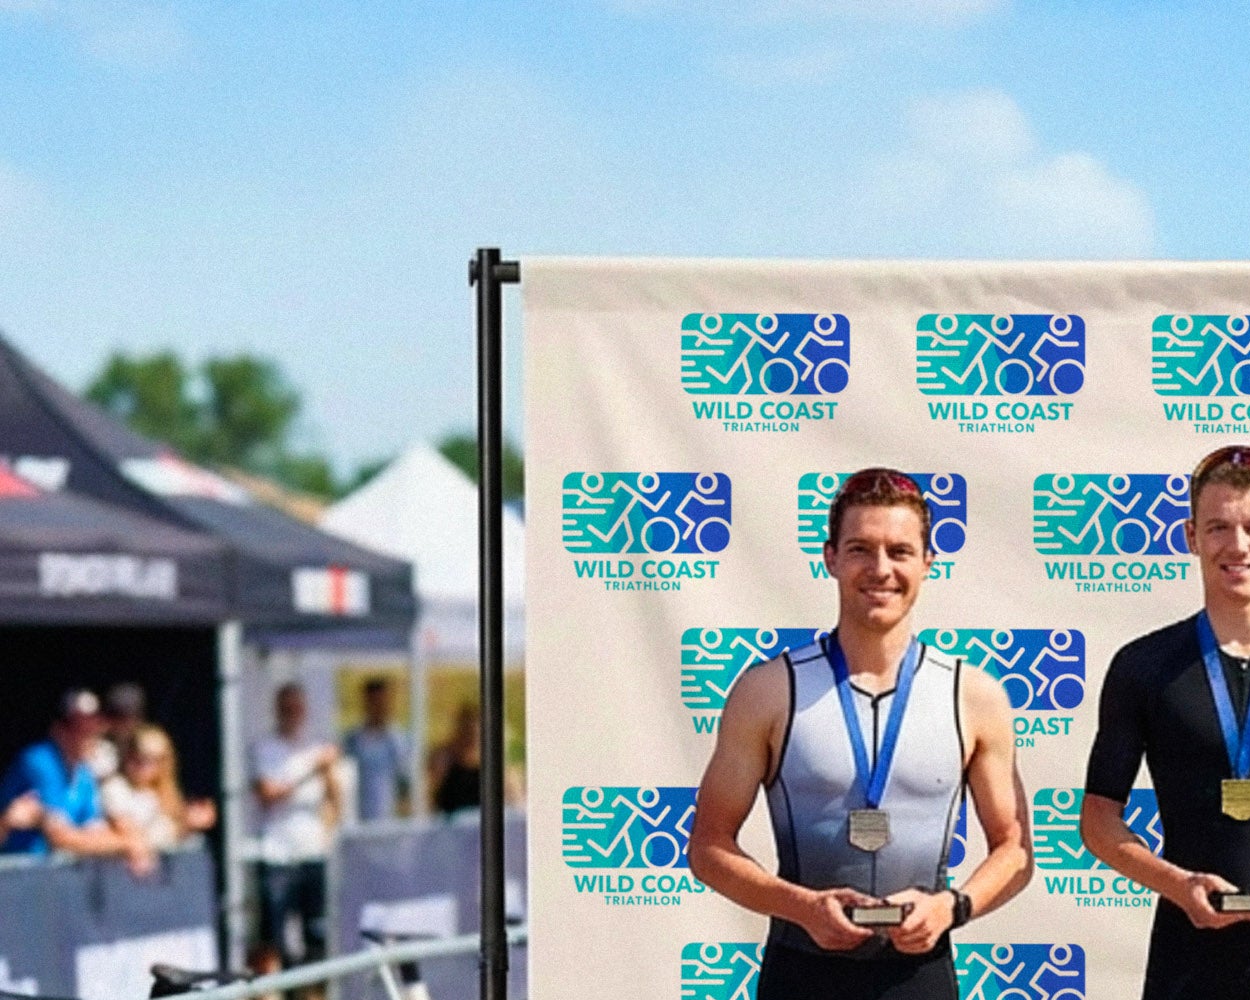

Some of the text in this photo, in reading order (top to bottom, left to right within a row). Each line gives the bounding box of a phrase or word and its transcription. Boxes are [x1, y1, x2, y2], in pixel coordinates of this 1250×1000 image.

[691, 401, 838, 420] WILD COAST
[927, 402, 1073, 420] WILD COAST
[1162, 403, 1224, 421] WILD
[723, 422, 799, 432] TRIATHLON
[959, 423, 1034, 432] TRIATHLON
[573, 560, 719, 579] WILD COAST
[1044, 562, 1190, 580] WILD COAST
[605, 581, 680, 590] TRIATHLON
[1076, 583, 1151, 592] TRIATHLON
[1013, 717, 1073, 735] OAST
[573, 875, 705, 893] WILD COAS
[1043, 877, 1105, 894] WILD
[605, 896, 680, 905] TRIATHLON
[1076, 898, 1151, 907] TRIATHLON
